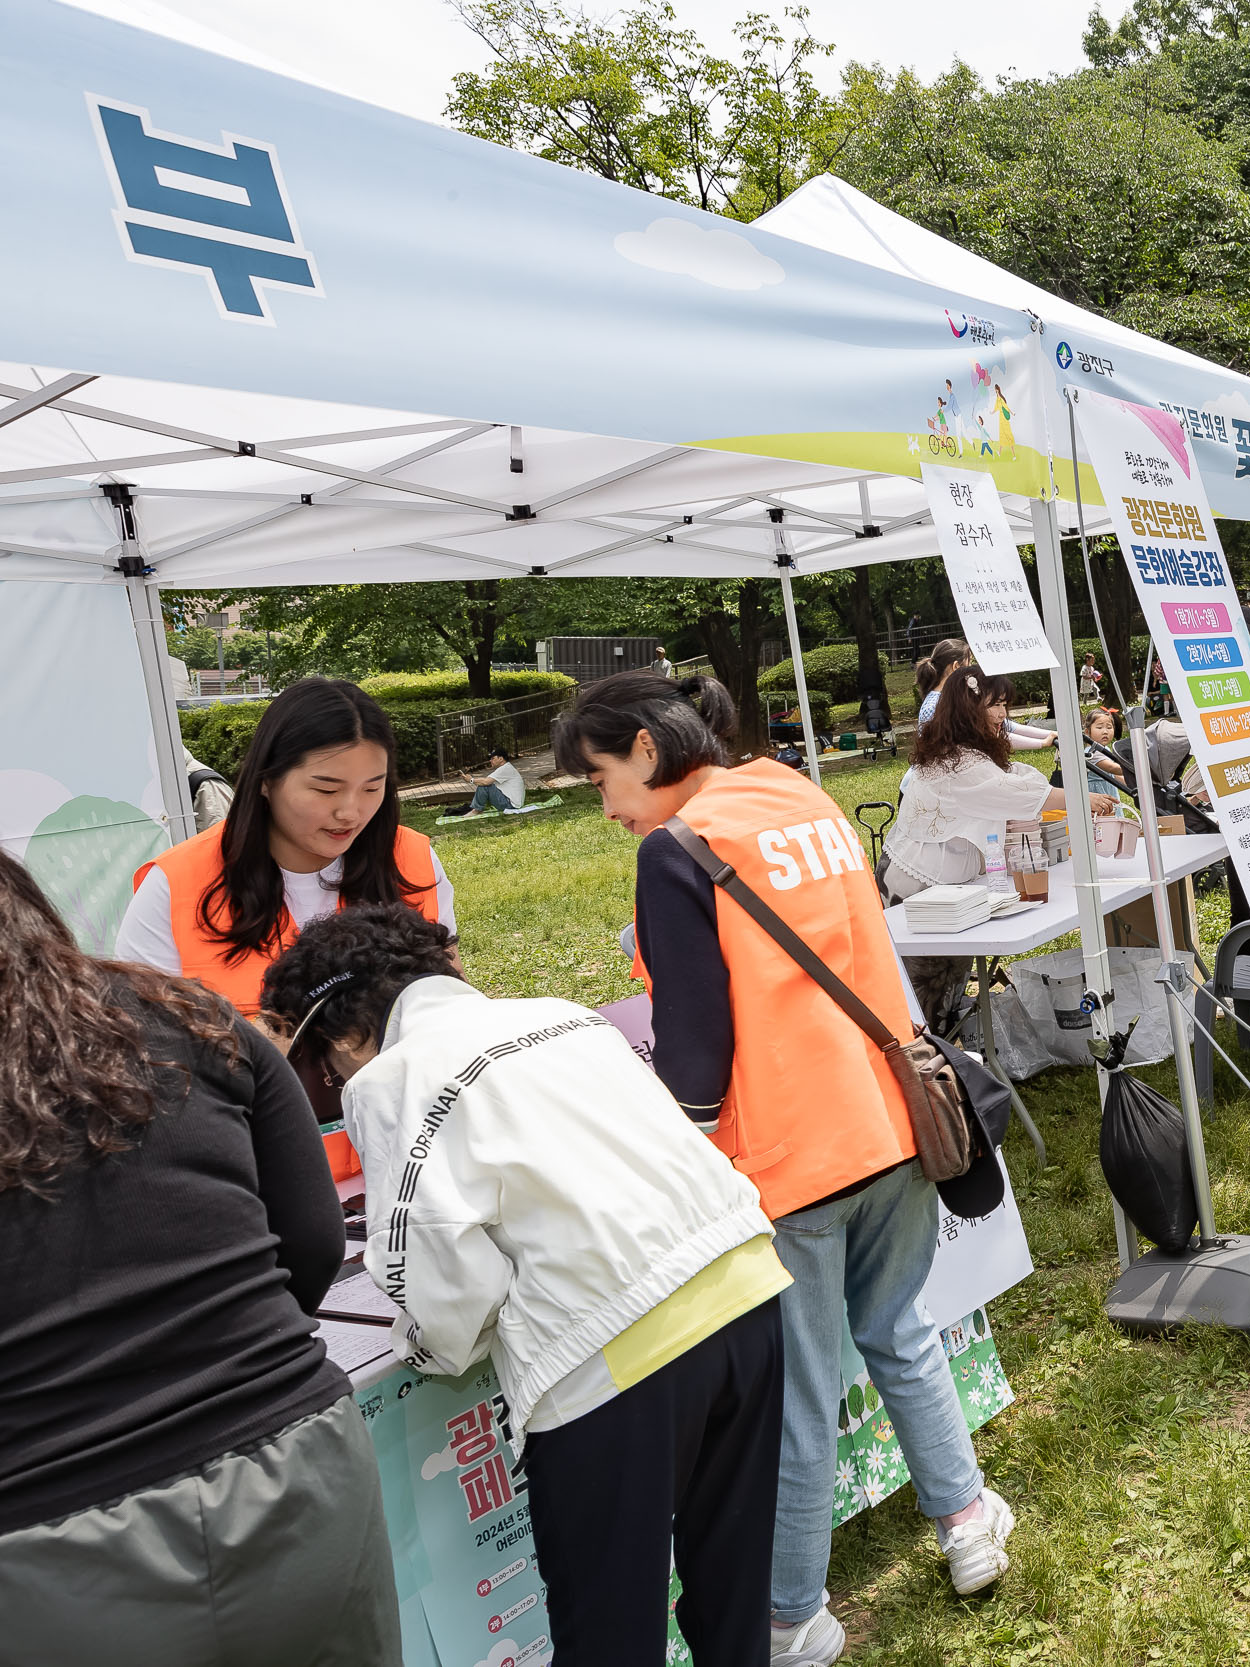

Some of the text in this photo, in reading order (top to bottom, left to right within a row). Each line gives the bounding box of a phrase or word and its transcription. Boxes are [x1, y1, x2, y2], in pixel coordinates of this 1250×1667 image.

[90, 97, 322, 322] 부
[1077, 351, 1114, 377] 광진구
[949, 483, 974, 509] 현장
[1121, 496, 1207, 541] 광진문화원
[953, 522, 994, 547] 접수자
[1130, 544, 1227, 587] 문화예술강좌
[956, 580, 1023, 594] 1. 신청서 작성 및 제출
[961, 603, 970, 613] 2.
[516, 1017, 590, 1049] ORIGINAL
[475, 1513, 515, 1547] 2024년
[478, 1581, 490, 1594] 1부
[490, 1617, 502, 1631] 2부
